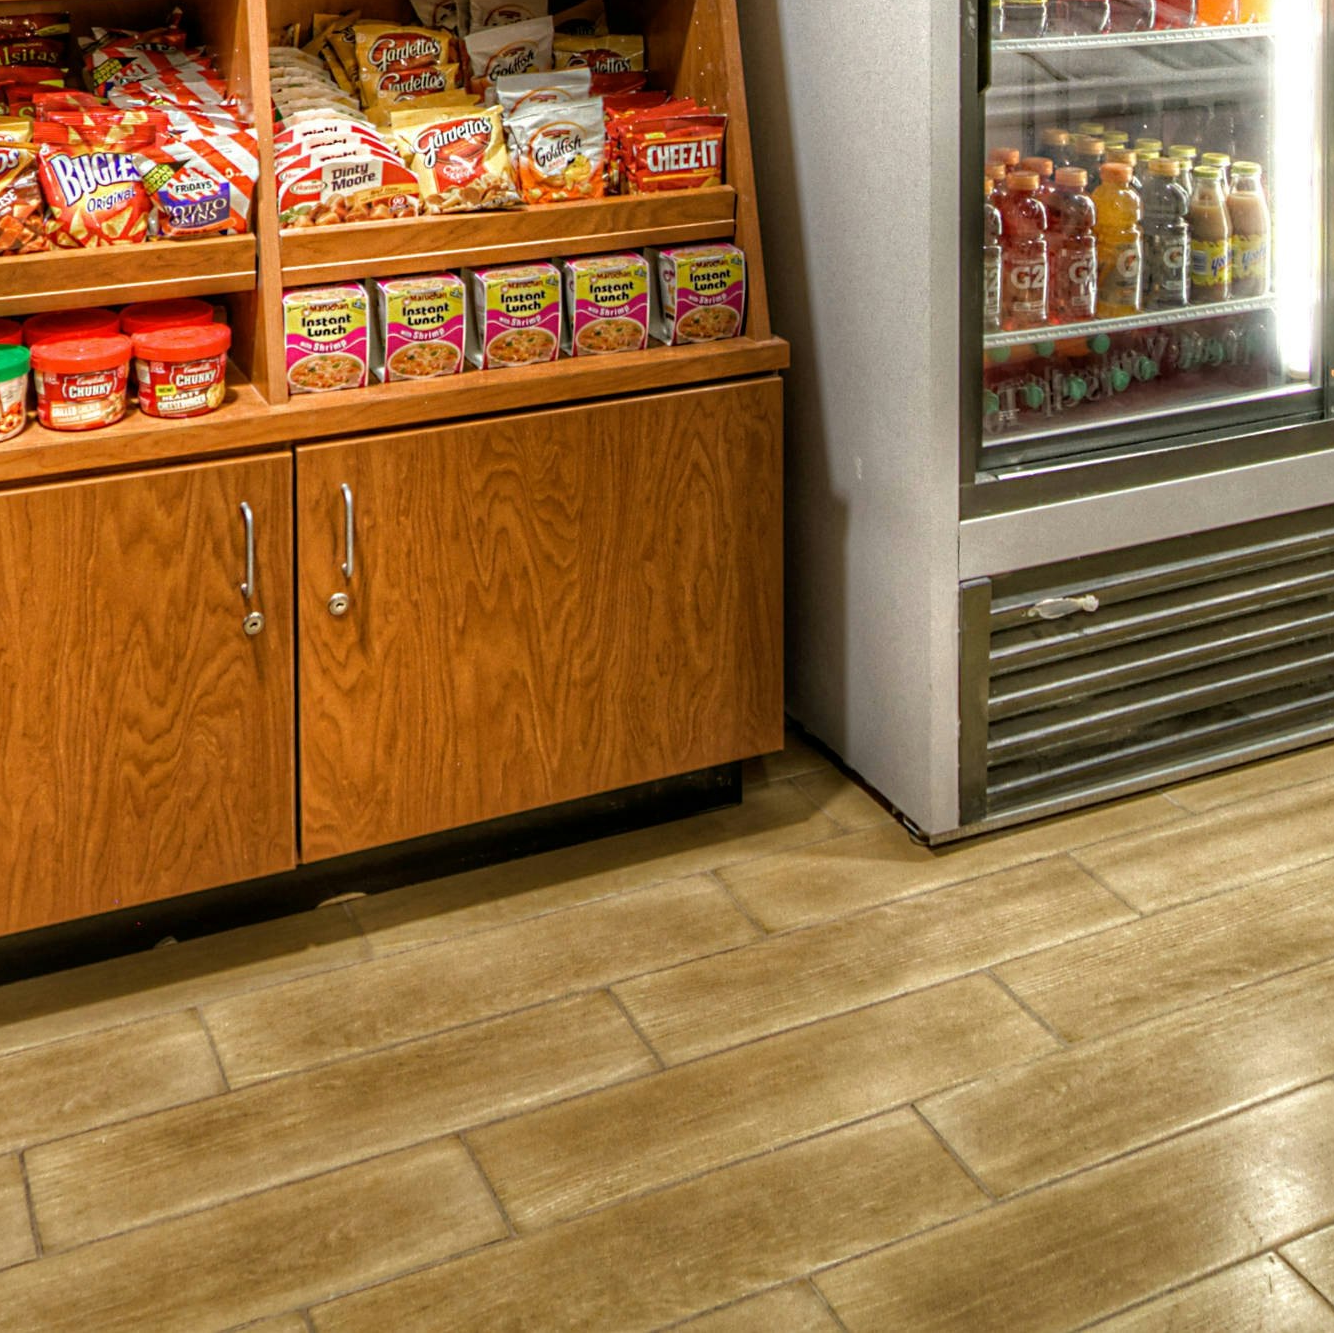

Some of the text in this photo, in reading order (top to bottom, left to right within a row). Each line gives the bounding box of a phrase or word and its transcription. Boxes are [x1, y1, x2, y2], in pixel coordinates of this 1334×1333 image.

[368, 38, 441, 74] Gardetto's
[408, 117, 493, 168] Gardetto's
[535, 137, 582, 168] Goldfish
[647, 140, 718, 173] CHEEZ-IT
[332, 163, 369, 180] Dinty
[332, 172, 376, 192] Moore
[690, 270, 731, 283] Instant
[1011, 266, 1044, 289] G2
[589, 282, 635, 294] Instant
[694, 280, 727, 292] Lunch
[500, 290, 546, 303] Instant
[594, 291, 630, 303] Lunch
[699, 293, 727, 306] Shrimp
[402, 303, 450, 316] Instant
[505, 301, 541, 313] Lunch
[600, 305, 630, 317] Shrimp
[301, 314, 352, 328] Instant
[407, 314, 445, 326] Lunch
[511, 315, 541, 327] Shrimp
[307, 326, 346, 337] Lunch
[413, 327, 445, 340] Shrimp
[313, 340, 347, 353] Shrimp
[175, 369, 217, 387] CHUNKY
[68, 382, 113, 399] CHUNKY
